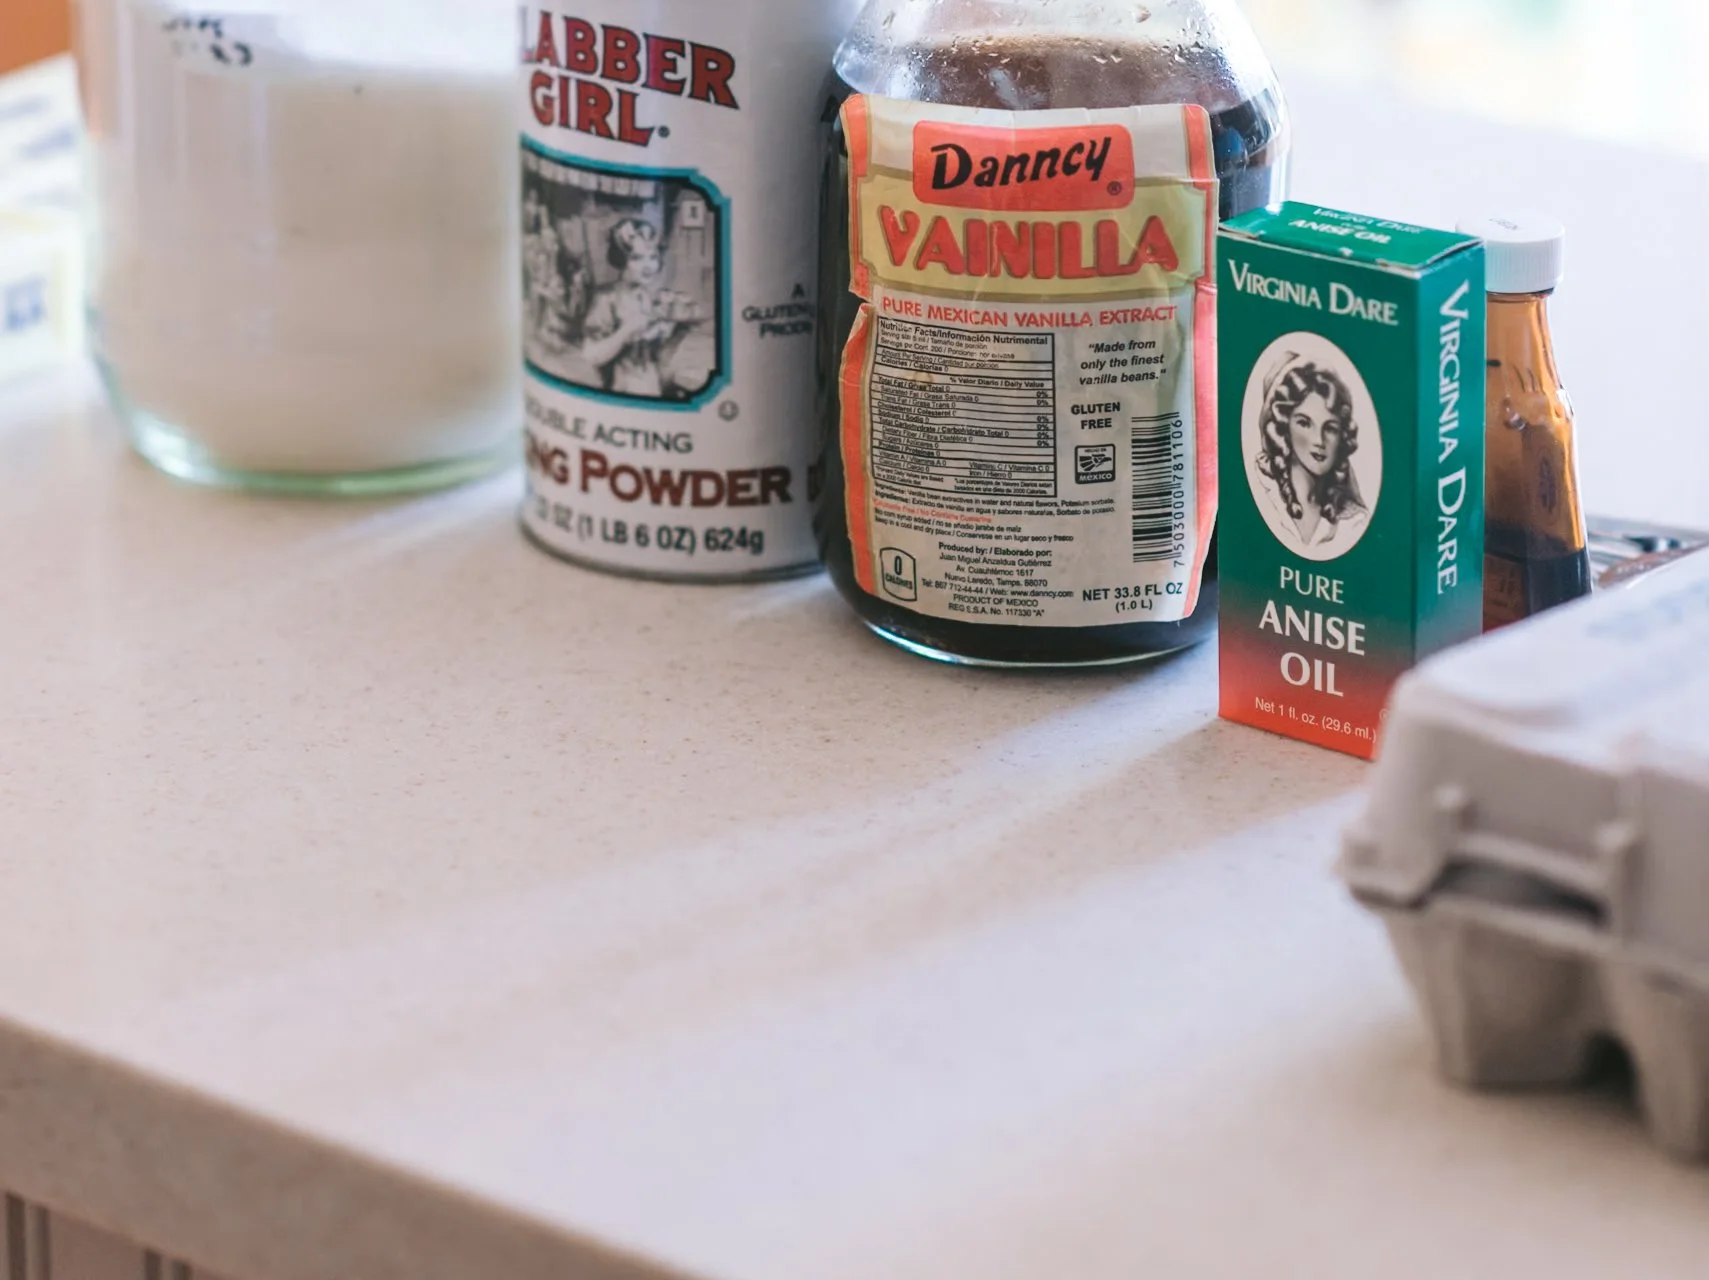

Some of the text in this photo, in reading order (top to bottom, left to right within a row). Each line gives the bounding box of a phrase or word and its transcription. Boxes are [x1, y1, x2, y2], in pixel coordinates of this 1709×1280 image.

[530, 70, 655, 148] GIRL
[930, 136, 1112, 191] Danncy
[878, 204, 1180, 280] VAINILLA
[1354, 231, 1392, 244] OIL
[1227, 258, 1399, 326] VIRGINIA DARE
[882, 296, 1177, 329] PURE MEXICAN VANILLA EXTRACT
[993, 335, 1048, 345] Nutrimental
[1128, 339, 1157, 351] from
[1080, 353, 1165, 371] only the finest
[1004, 380, 1023, 389] Daily
[1079, 373, 1118, 386] vanilla
[1071, 401, 1121, 415] GLUTEN
[1080, 417, 1113, 430] FREE
[593, 423, 693, 454] ACTING
[1436, 277, 1470, 596] VIRGINIA DARE
[578, 447, 795, 509] POWDER
[1013, 499, 1034, 507] natural
[601, 517, 629, 545] LB
[636, 523, 650, 548] 6
[704, 526, 764, 556] 624g
[938, 541, 974, 554] Produced
[994, 547, 1035, 558] Elaborado
[939, 552, 957, 562] Juan
[957, 554, 981, 565] Miguel
[894, 555, 903, 576] 0
[1010, 588, 1074, 600] www.danncy.com
[1082, 581, 1184, 602] NET 33.8 FL OZ
[1280, 565, 1344, 605] PURE
[952, 593, 1040, 608] PRODUCT OF MEXICO
[1115, 598, 1153, 614] (1.0 L)
[1258, 599, 1366, 656] ANISE
[1280, 652, 1344, 697] OIL
[1255, 696, 1377, 744] Net 1 fl. oz. (29.6 ml.)
